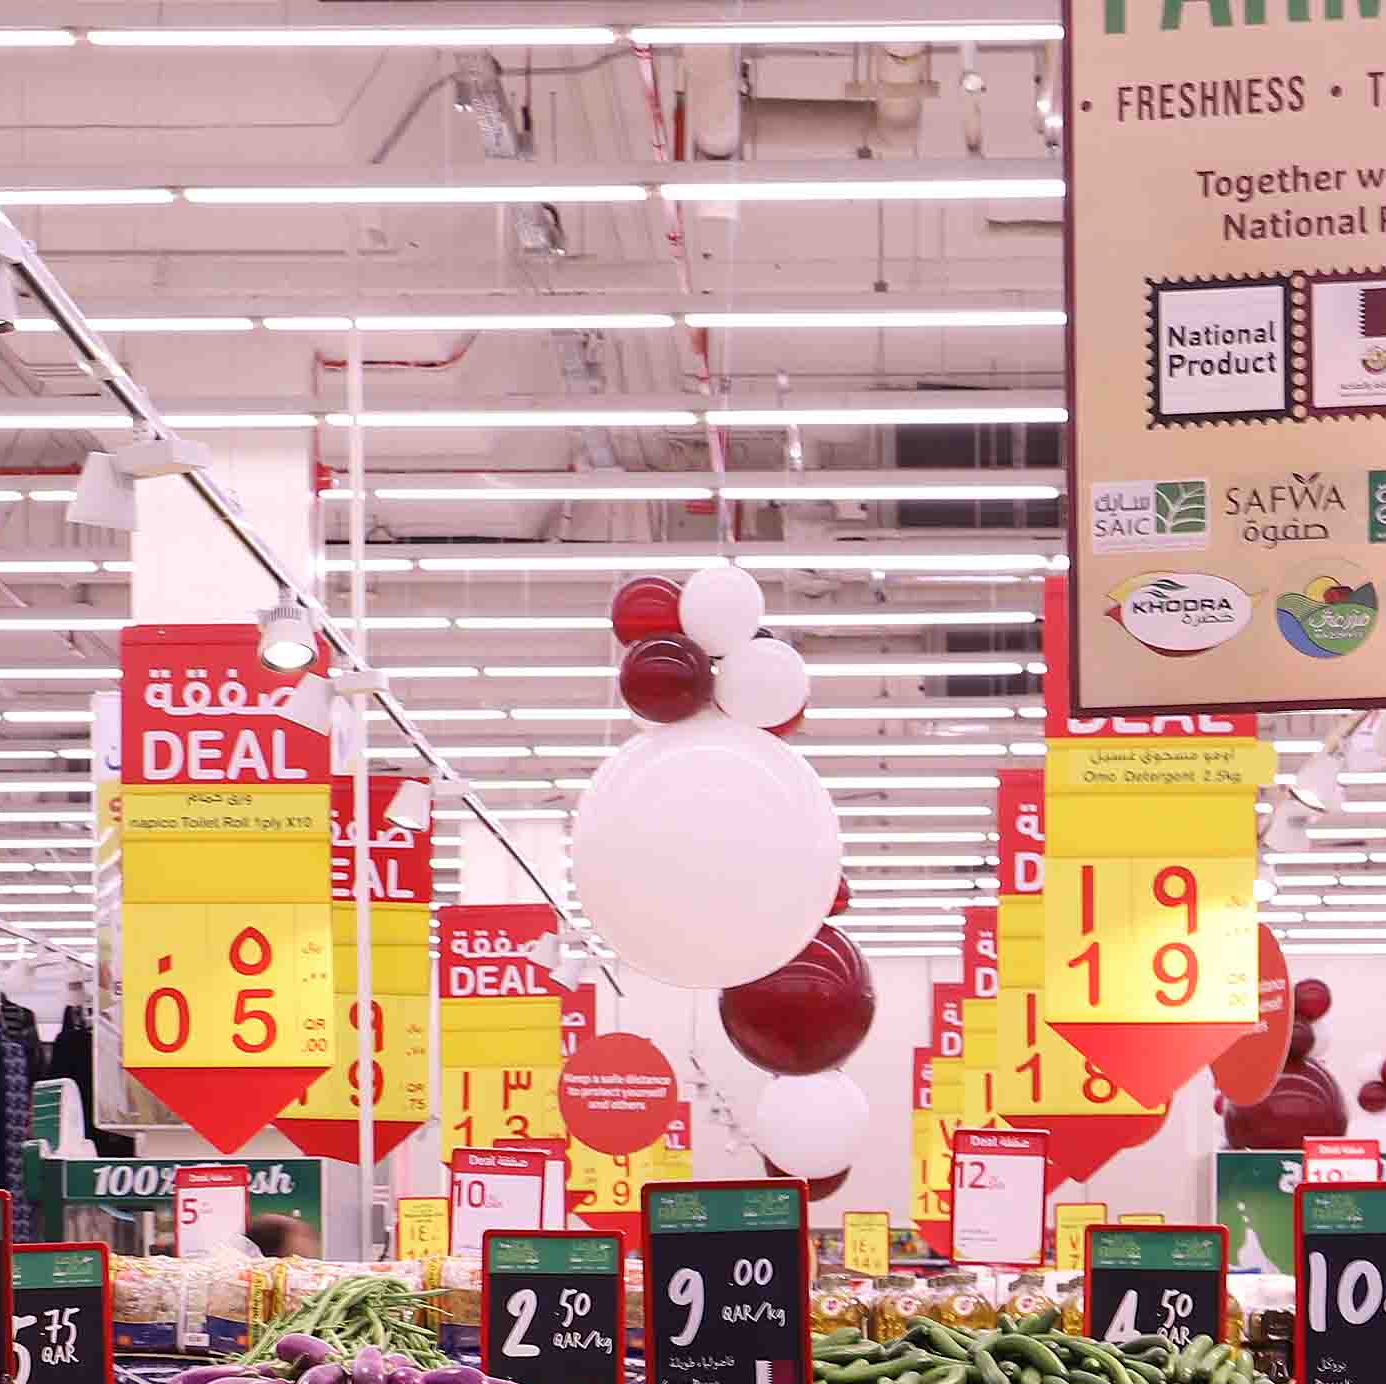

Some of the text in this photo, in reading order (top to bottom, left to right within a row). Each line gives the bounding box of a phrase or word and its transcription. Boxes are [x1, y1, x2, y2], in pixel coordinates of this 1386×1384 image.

[1118, 76, 1304, 122] FRESHNESS
[1197, 165, 1347, 203] Together
[1224, 206, 1367, 240] National
[1226, 484, 1346, 516] SAFWA
[1133, 599, 1232, 613] KHODRA
[144, 730, 307, 781] DEAL
[451, 965, 549, 996] DEAL
[955, 1162, 986, 1188] 12
[668, 1268, 704, 1346] 9
[1309, 1252, 1382, 1332] 10
[502, 1289, 540, 1357] 2
[40, 1344, 79, 1365] QAR
